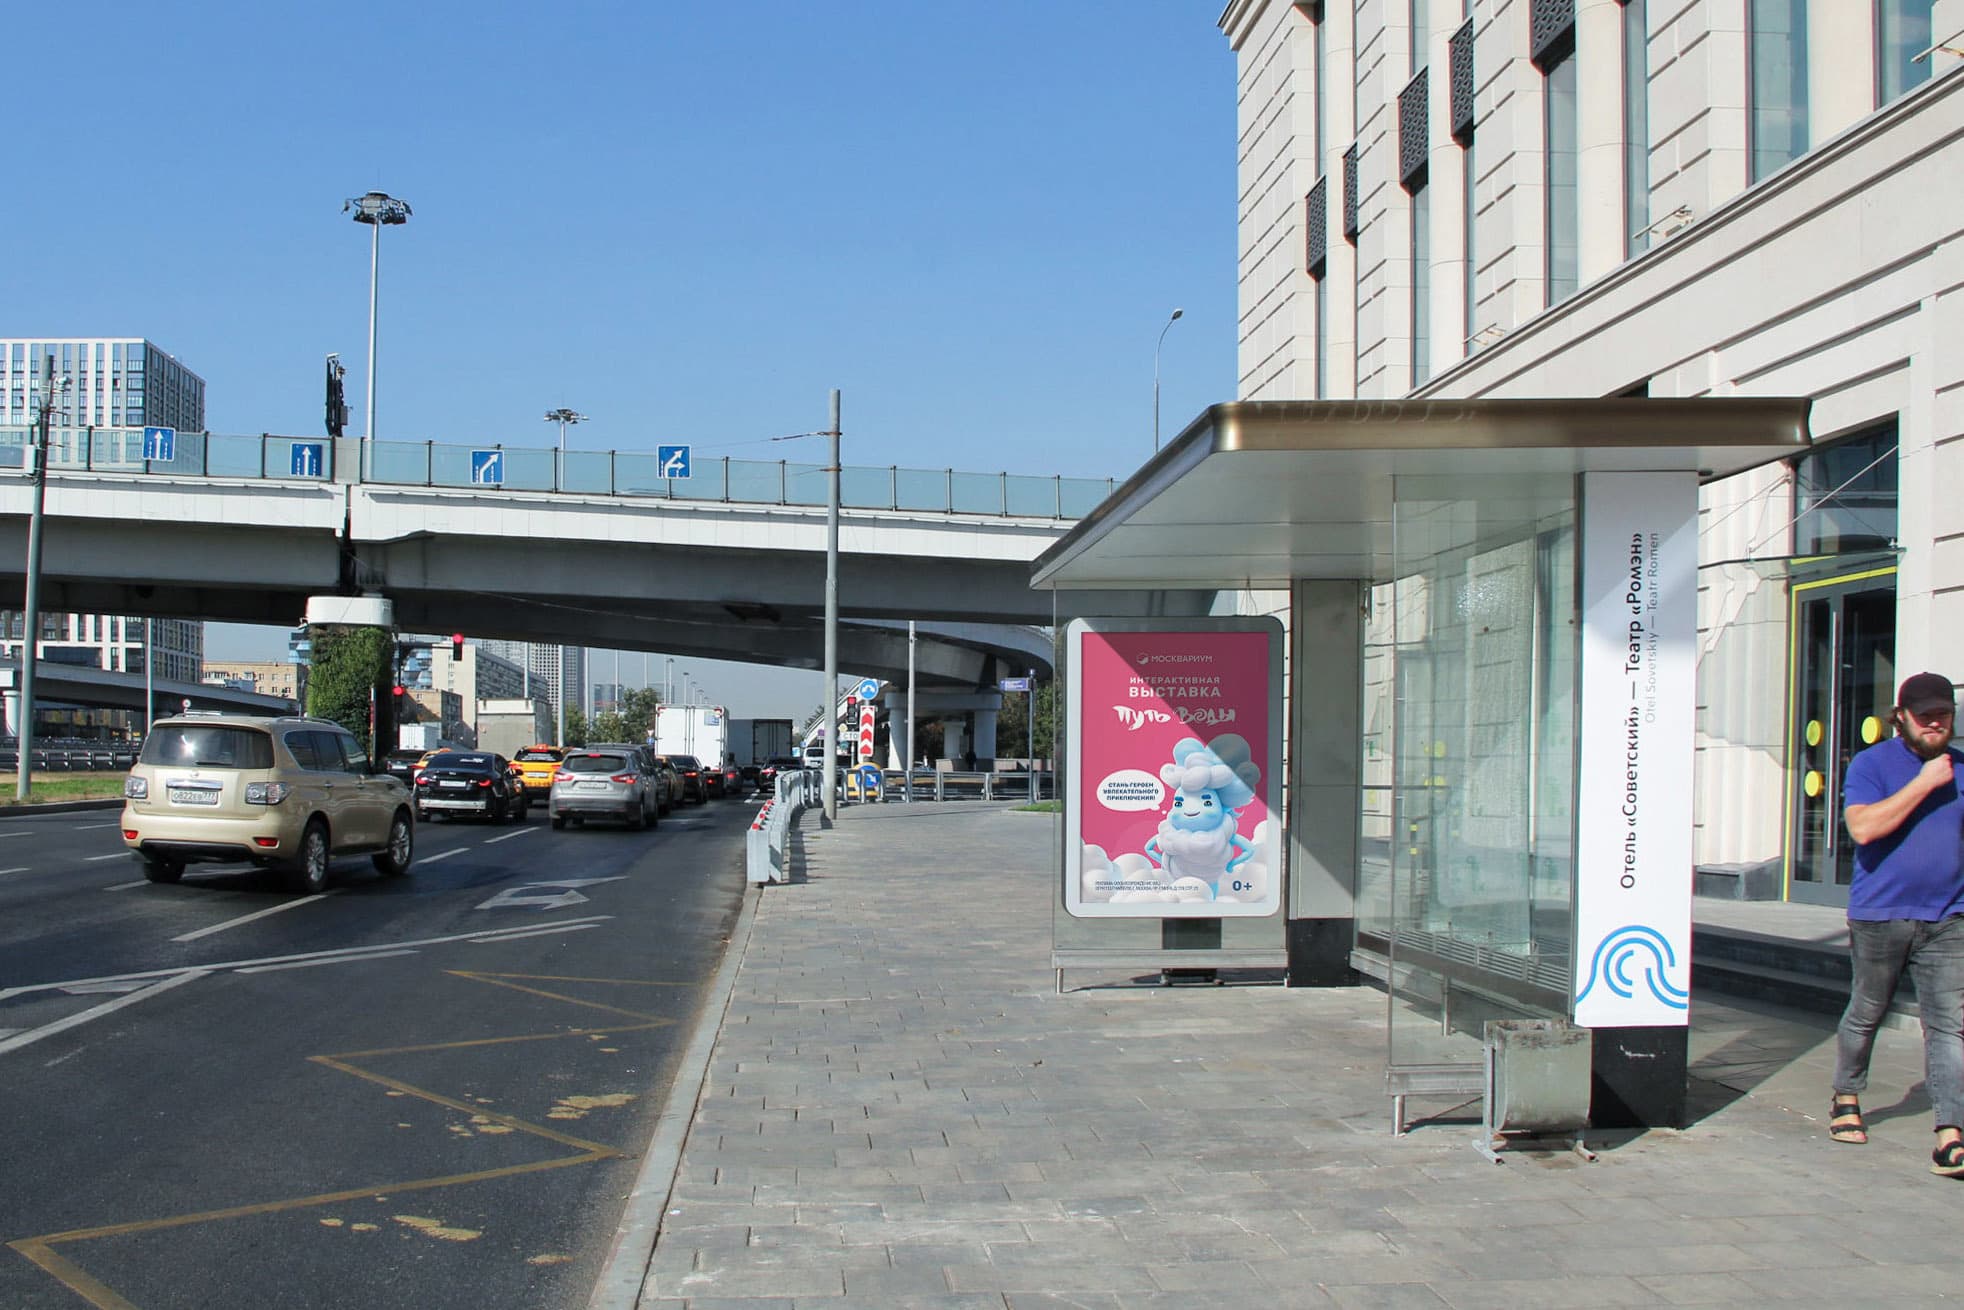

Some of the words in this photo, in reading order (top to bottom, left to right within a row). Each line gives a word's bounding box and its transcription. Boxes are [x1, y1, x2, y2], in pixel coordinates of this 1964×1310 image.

[1647, 532, 1659, 576] Romen
[1626, 533, 1643, 615] «Ромэн»
[1646, 580, 1658, 612] Teatr
[1151, 655, 1213, 663] МОСКВАРИУМ
[1625, 620, 1644, 675] Театр
[1645, 633, 1660, 693] Sovetskiy
[1129, 676, 1221, 684] ИНТЕРАКТИВНАЯ
[1129, 686, 1222, 698] ВЫСТАВКА
[1645, 696, 1656, 724] Otel
[1622, 706, 1640, 827] «Советский»
[1620, 831, 1637, 889] Отель
[1232, 880, 1253, 892] 0+
